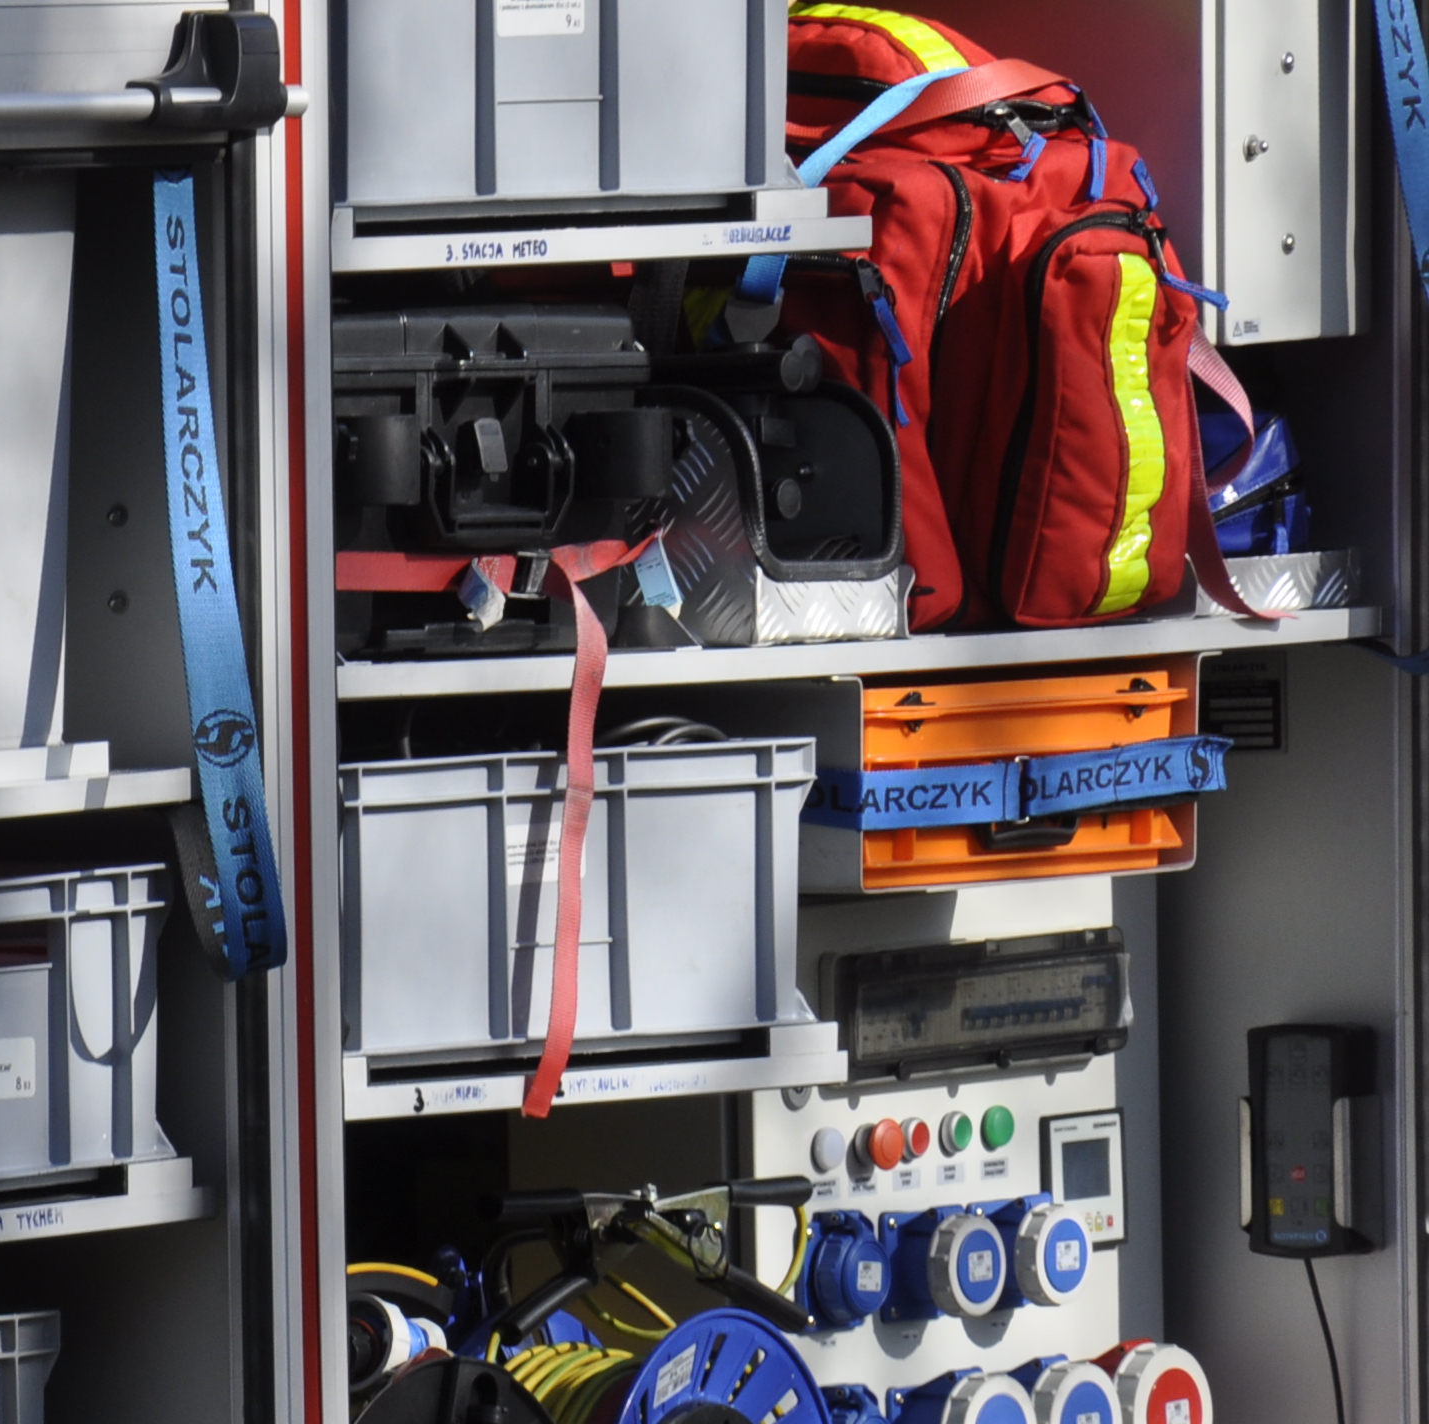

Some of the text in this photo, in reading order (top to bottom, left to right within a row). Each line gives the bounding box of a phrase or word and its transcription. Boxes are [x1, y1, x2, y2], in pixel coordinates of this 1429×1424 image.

[462, 241, 504, 261] STACJA
[512, 239, 548, 259] METEO
[163, 214, 219, 595] STOLARCZYK
[15, 1076, 22, 1092] 8
[15, 1207, 65, 1231] TYCHEM
